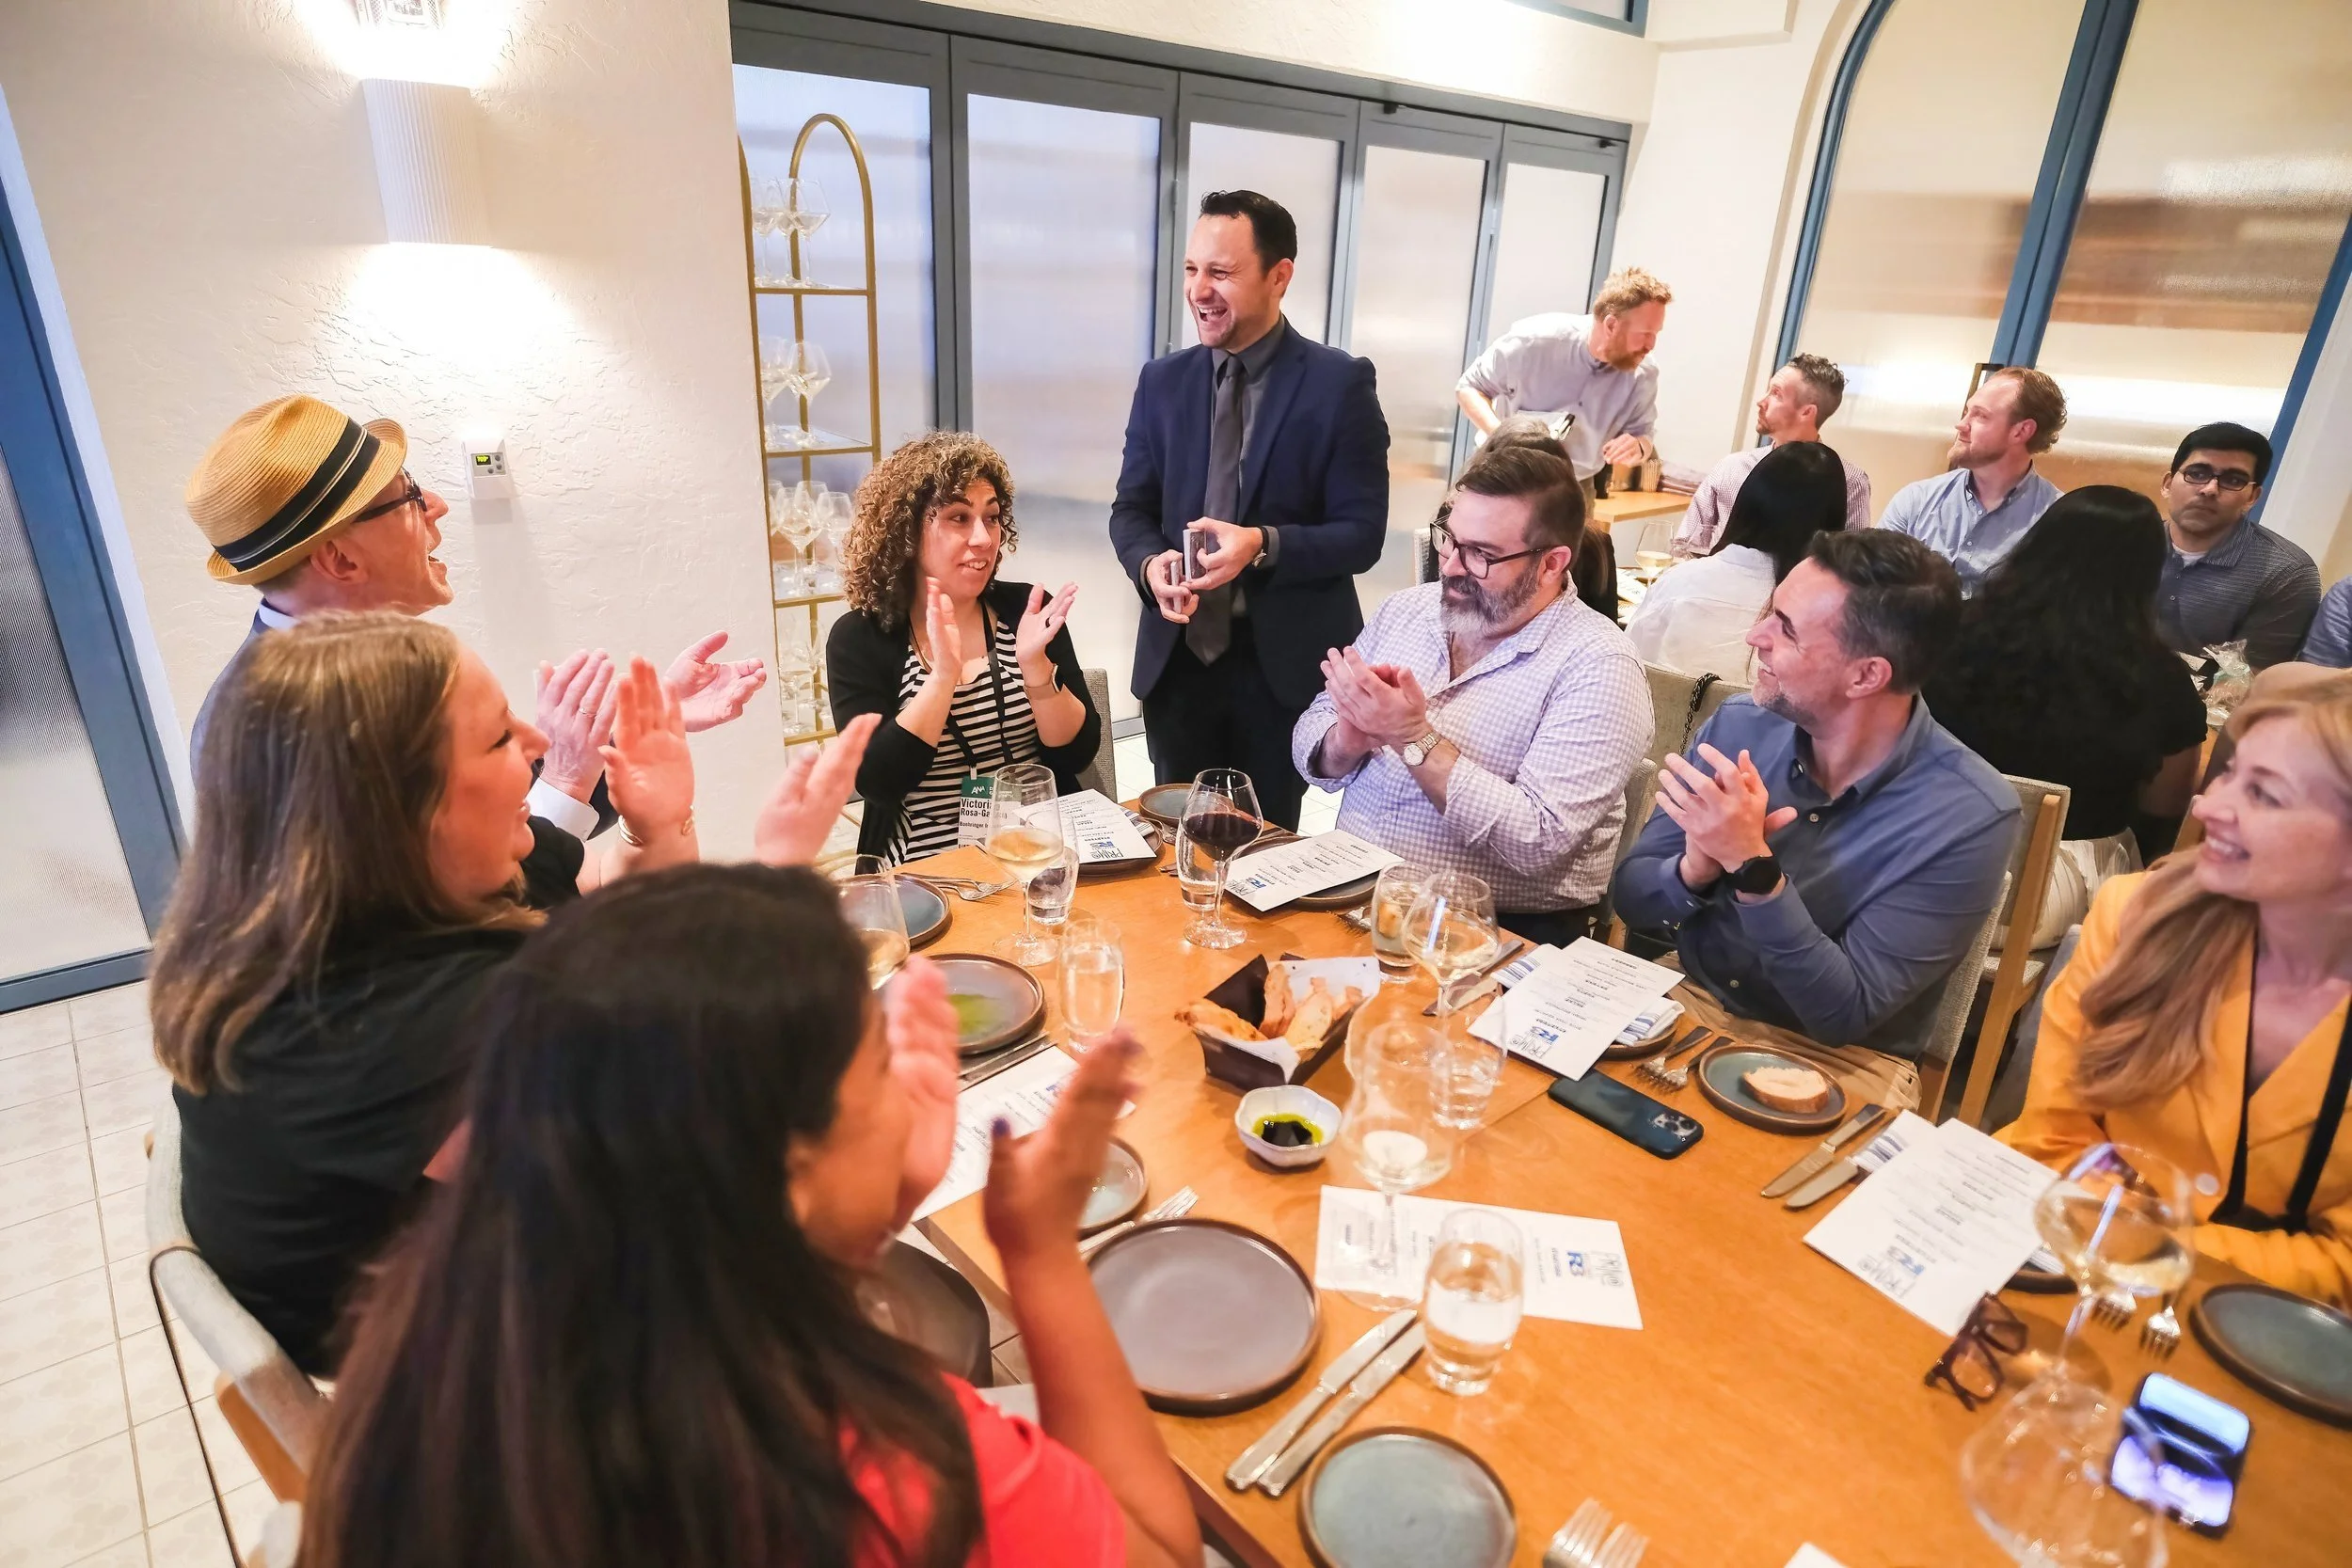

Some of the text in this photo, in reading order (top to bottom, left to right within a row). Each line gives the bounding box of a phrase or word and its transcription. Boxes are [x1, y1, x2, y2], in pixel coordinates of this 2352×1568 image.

[971, 785, 986, 795] ANA
[961, 798, 993, 810] Victori
[960, 807, 994, 818] Rosa-Ga
